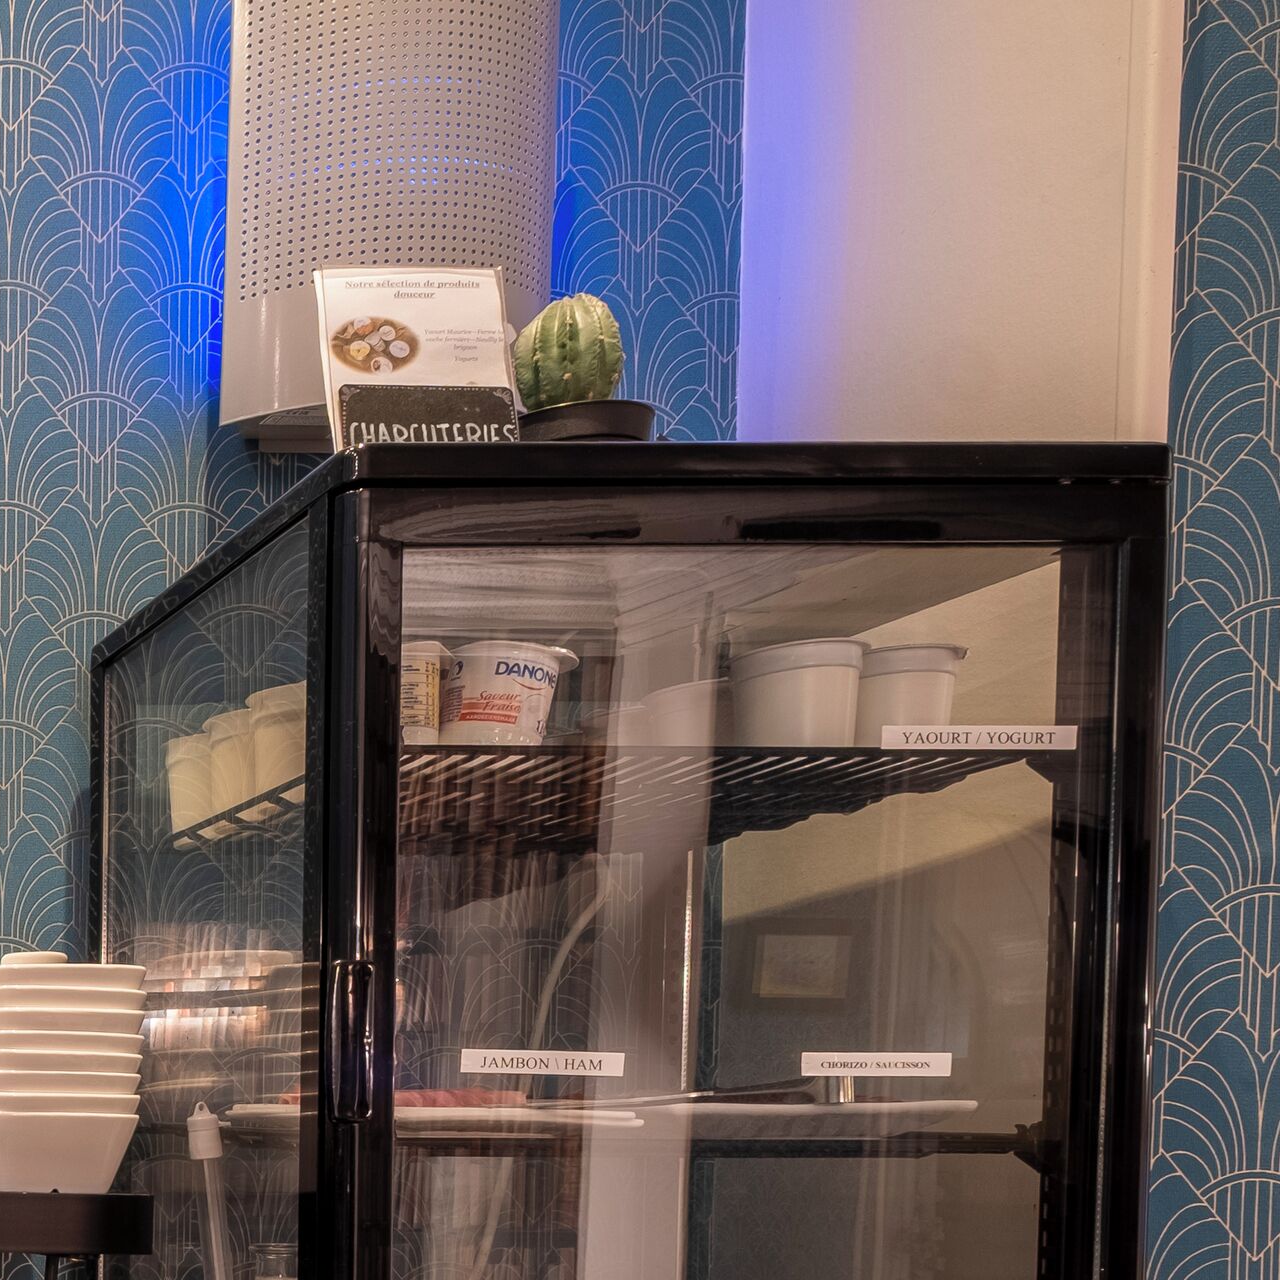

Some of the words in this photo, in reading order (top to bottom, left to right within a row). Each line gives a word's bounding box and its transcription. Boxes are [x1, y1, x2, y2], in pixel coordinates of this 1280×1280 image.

[344, 280, 374, 288] Notre
[376, 279, 421, 288] sélection
[423, 280, 435, 288] de
[437, 280, 481, 289] produits
[393, 290, 435, 299] douceur
[494, 660, 557, 690] DANONE
[478, 689, 521, 702] Saveur
[902, 731, 972, 745] YAOURT
[975, 731, 981, 745] /
[986, 731, 1057, 745] YOGURT
[480, 1055, 550, 1070] JAMBON
[564, 1058, 603, 1071] HAM
[820, 1061, 868, 1069] CHORIZO
[875, 1061, 931, 1069] SAUCISSON
